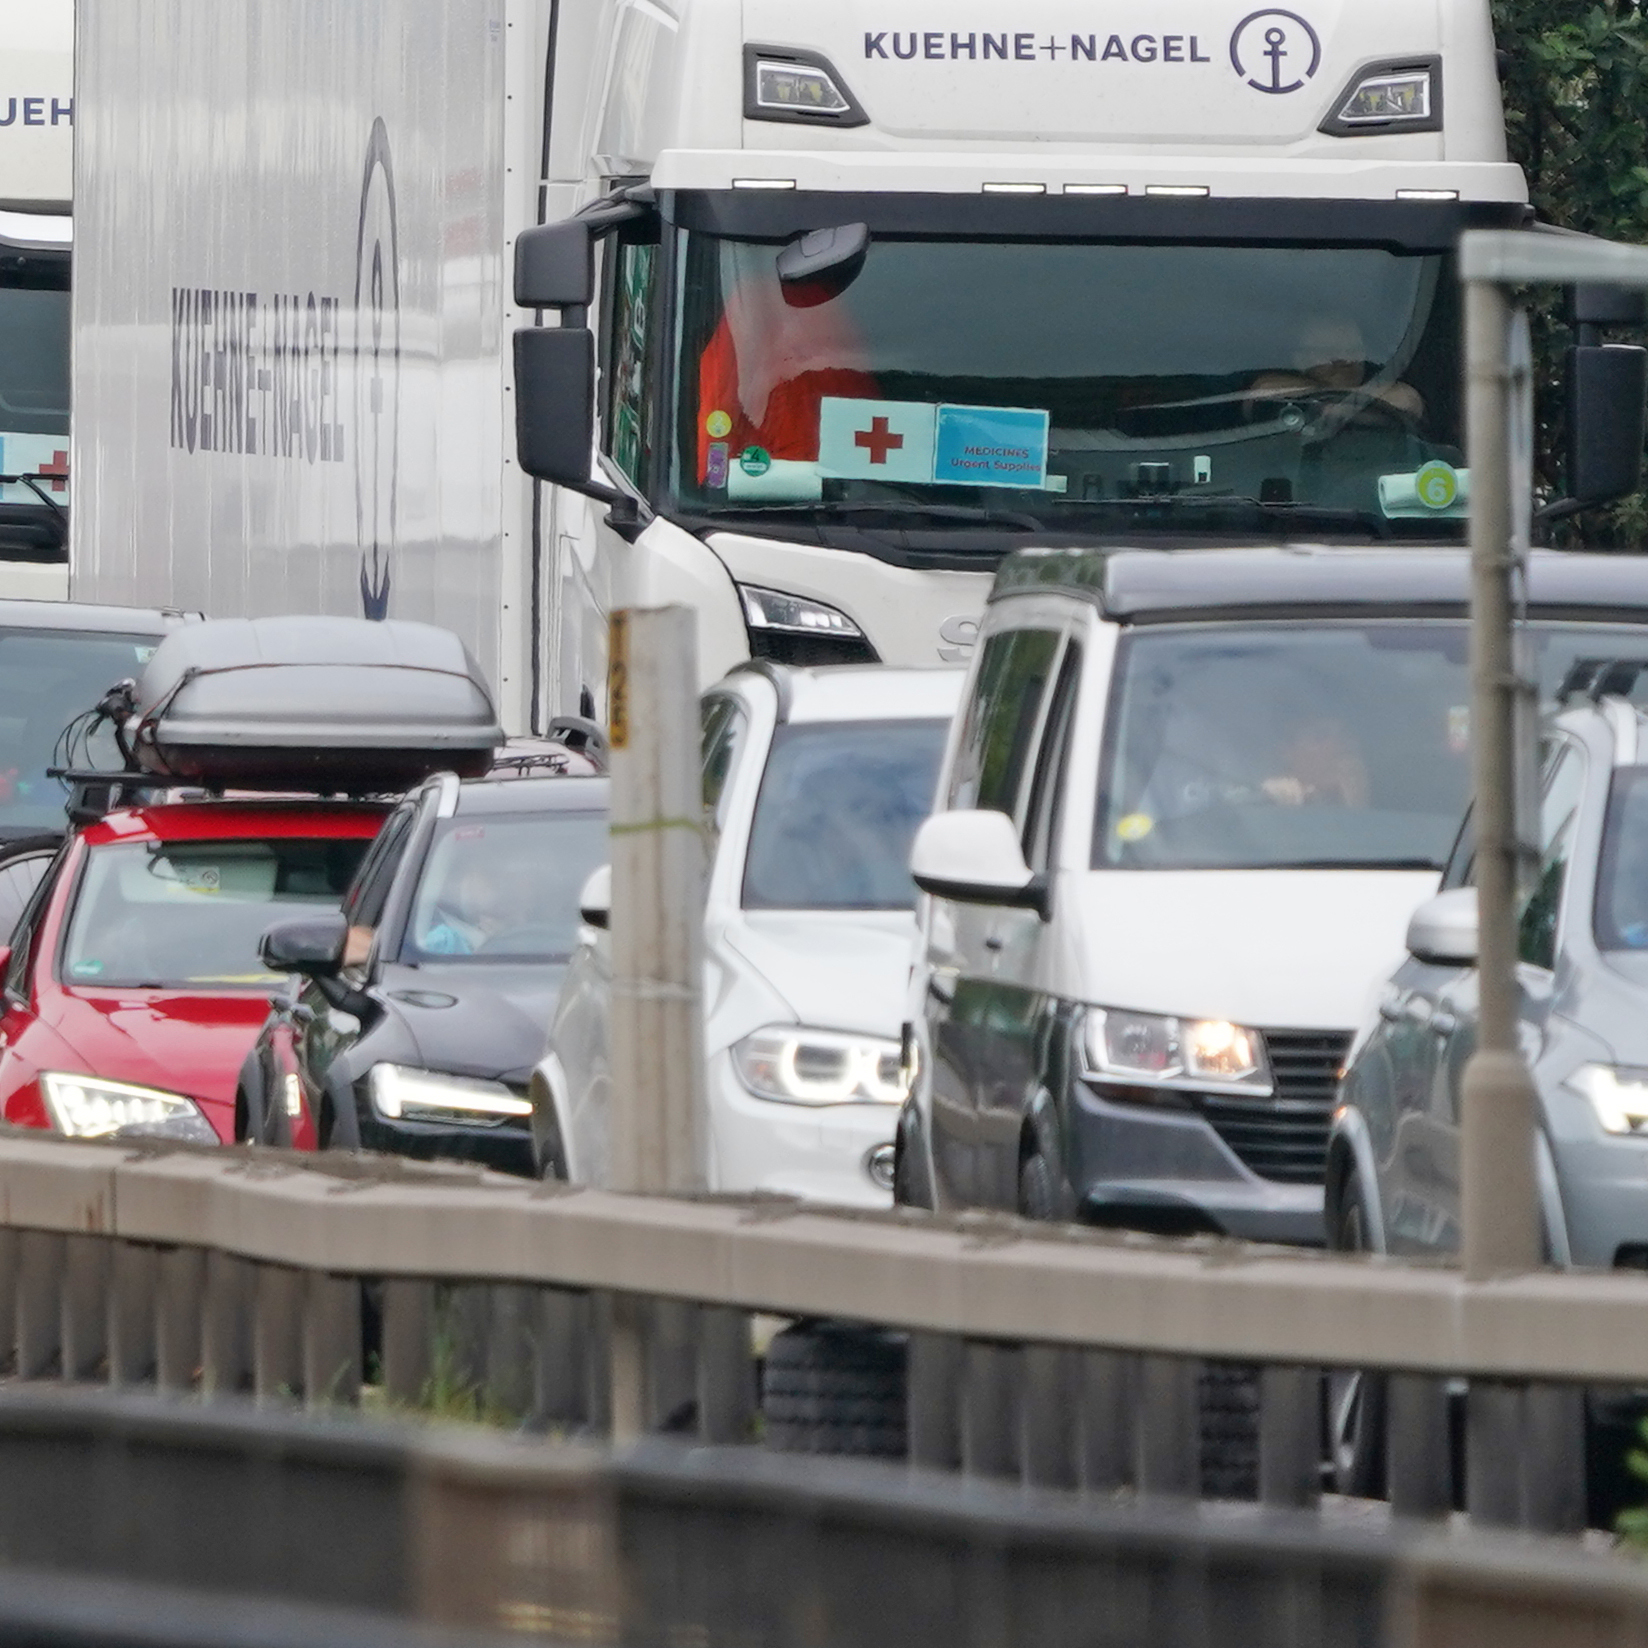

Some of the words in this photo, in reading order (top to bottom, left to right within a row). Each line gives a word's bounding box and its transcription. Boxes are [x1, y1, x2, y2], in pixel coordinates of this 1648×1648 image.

[863, 31, 1211, 63] KUEHNE+NAGEL
[170, 287, 344, 465] KUEHNE+NAGEL
[951, 458, 990, 470] Urgent
[994, 460, 1041, 472] Supplies
[964, 446, 1030, 459] MEDICINES
[1427, 477, 1447, 503] 6
